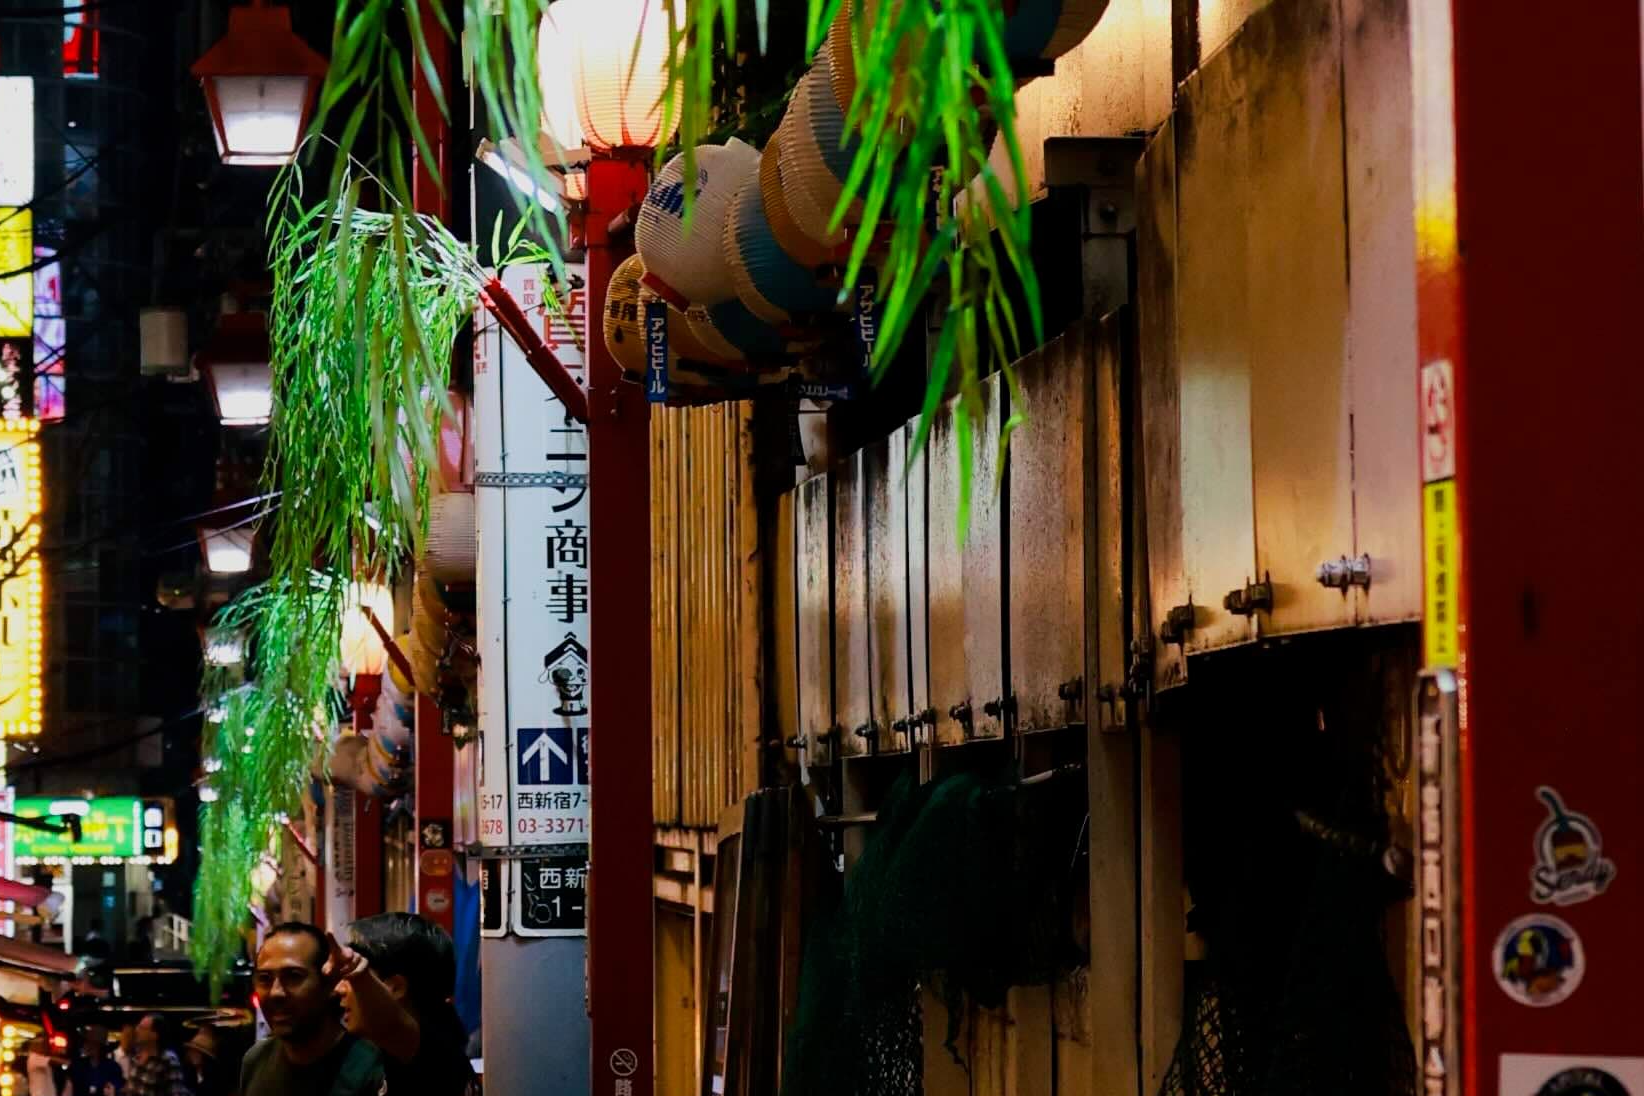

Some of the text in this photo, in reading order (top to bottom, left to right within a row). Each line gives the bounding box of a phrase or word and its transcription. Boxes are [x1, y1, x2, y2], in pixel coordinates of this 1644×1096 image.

[649, 316, 666, 394] アサヒビール
[544, 396, 589, 624] ニン商事
